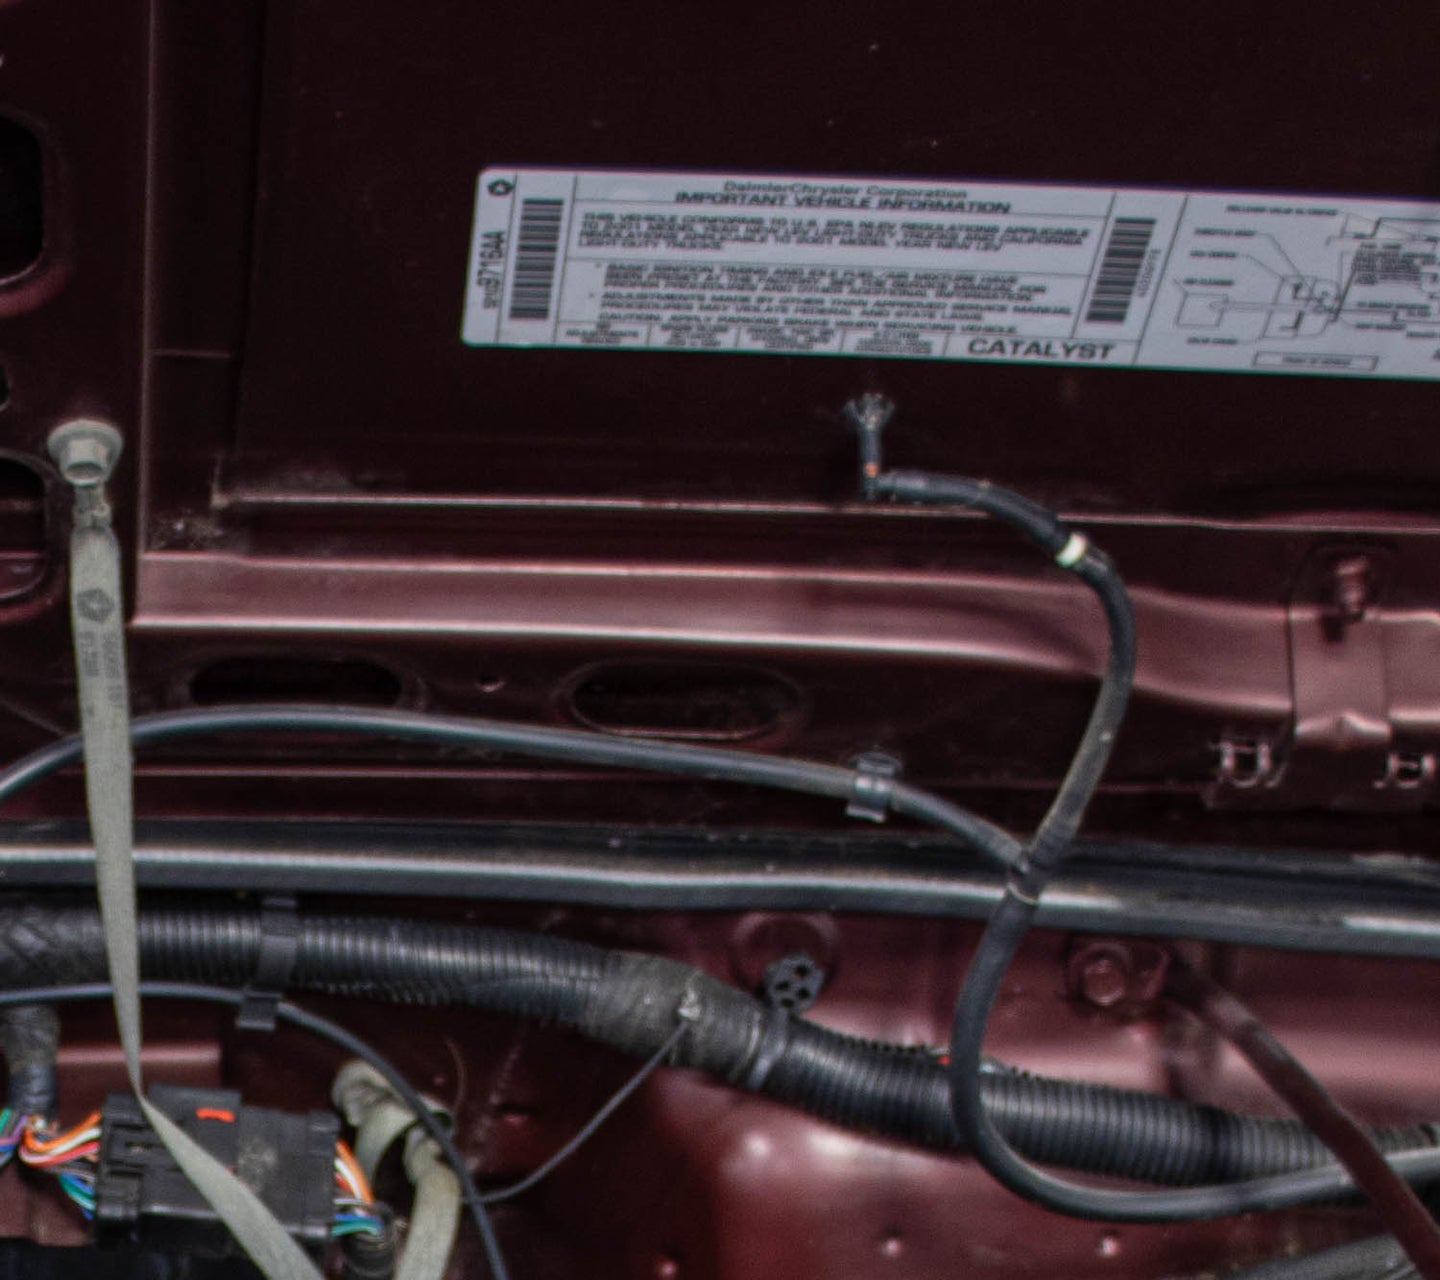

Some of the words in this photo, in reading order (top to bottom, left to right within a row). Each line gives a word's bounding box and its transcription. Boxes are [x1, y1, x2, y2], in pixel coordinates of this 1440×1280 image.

[724, 180, 861, 198] DaimlerChrysler
[866, 186, 967, 200] Corporation
[676, 191, 788, 206] IMPORTANT
[795, 195, 871, 209] VEHICLE
[877, 198, 1011, 214] INFORMATION
[968, 338, 1116, 361] CATALYST
